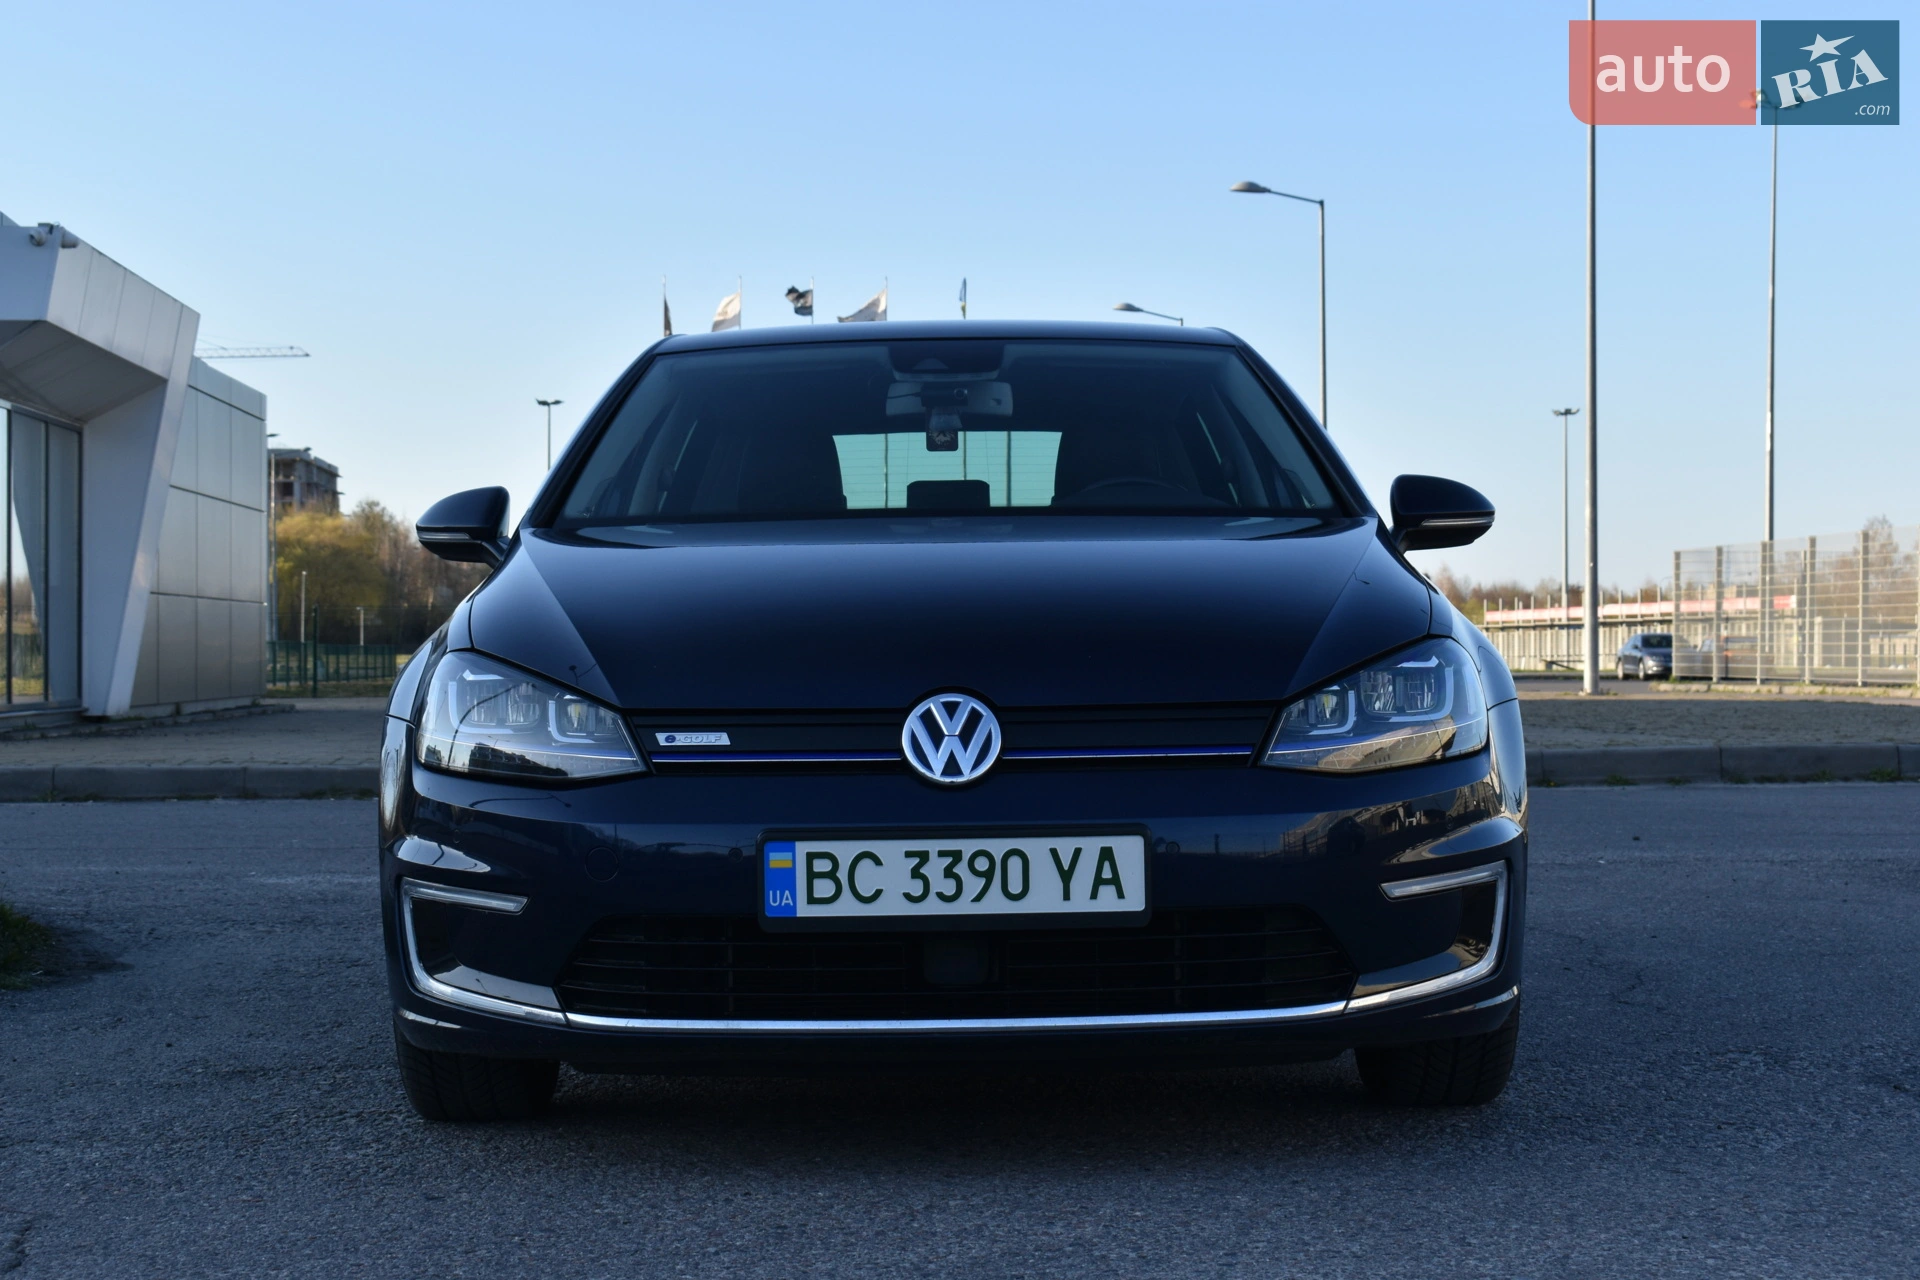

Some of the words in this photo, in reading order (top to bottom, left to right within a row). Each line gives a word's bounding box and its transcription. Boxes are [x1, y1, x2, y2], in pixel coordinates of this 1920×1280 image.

[805, 851, 884, 905] BC
[902, 848, 1030, 903] 3390
[1048, 846, 1126, 901] YA
[769, 890, 794, 907] UA
